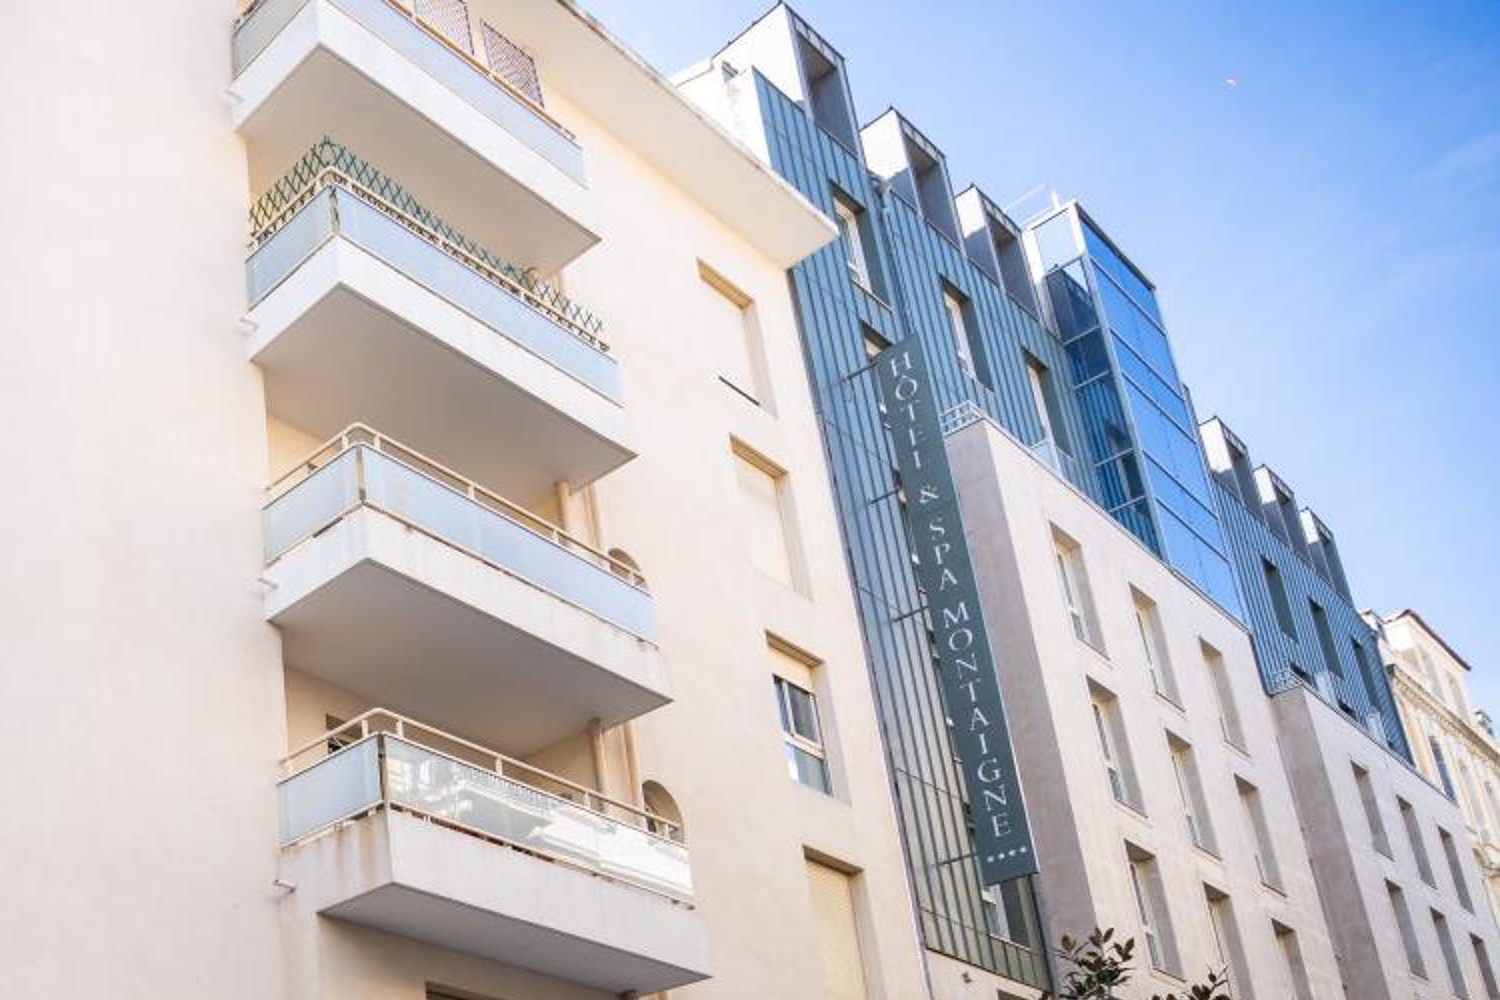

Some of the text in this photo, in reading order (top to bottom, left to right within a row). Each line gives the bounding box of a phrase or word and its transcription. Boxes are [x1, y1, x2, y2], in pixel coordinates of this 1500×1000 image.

[919, 483, 940, 504] &
[928, 517, 959, 591] SPA
[942, 600, 1012, 838] MONTAIGNE
